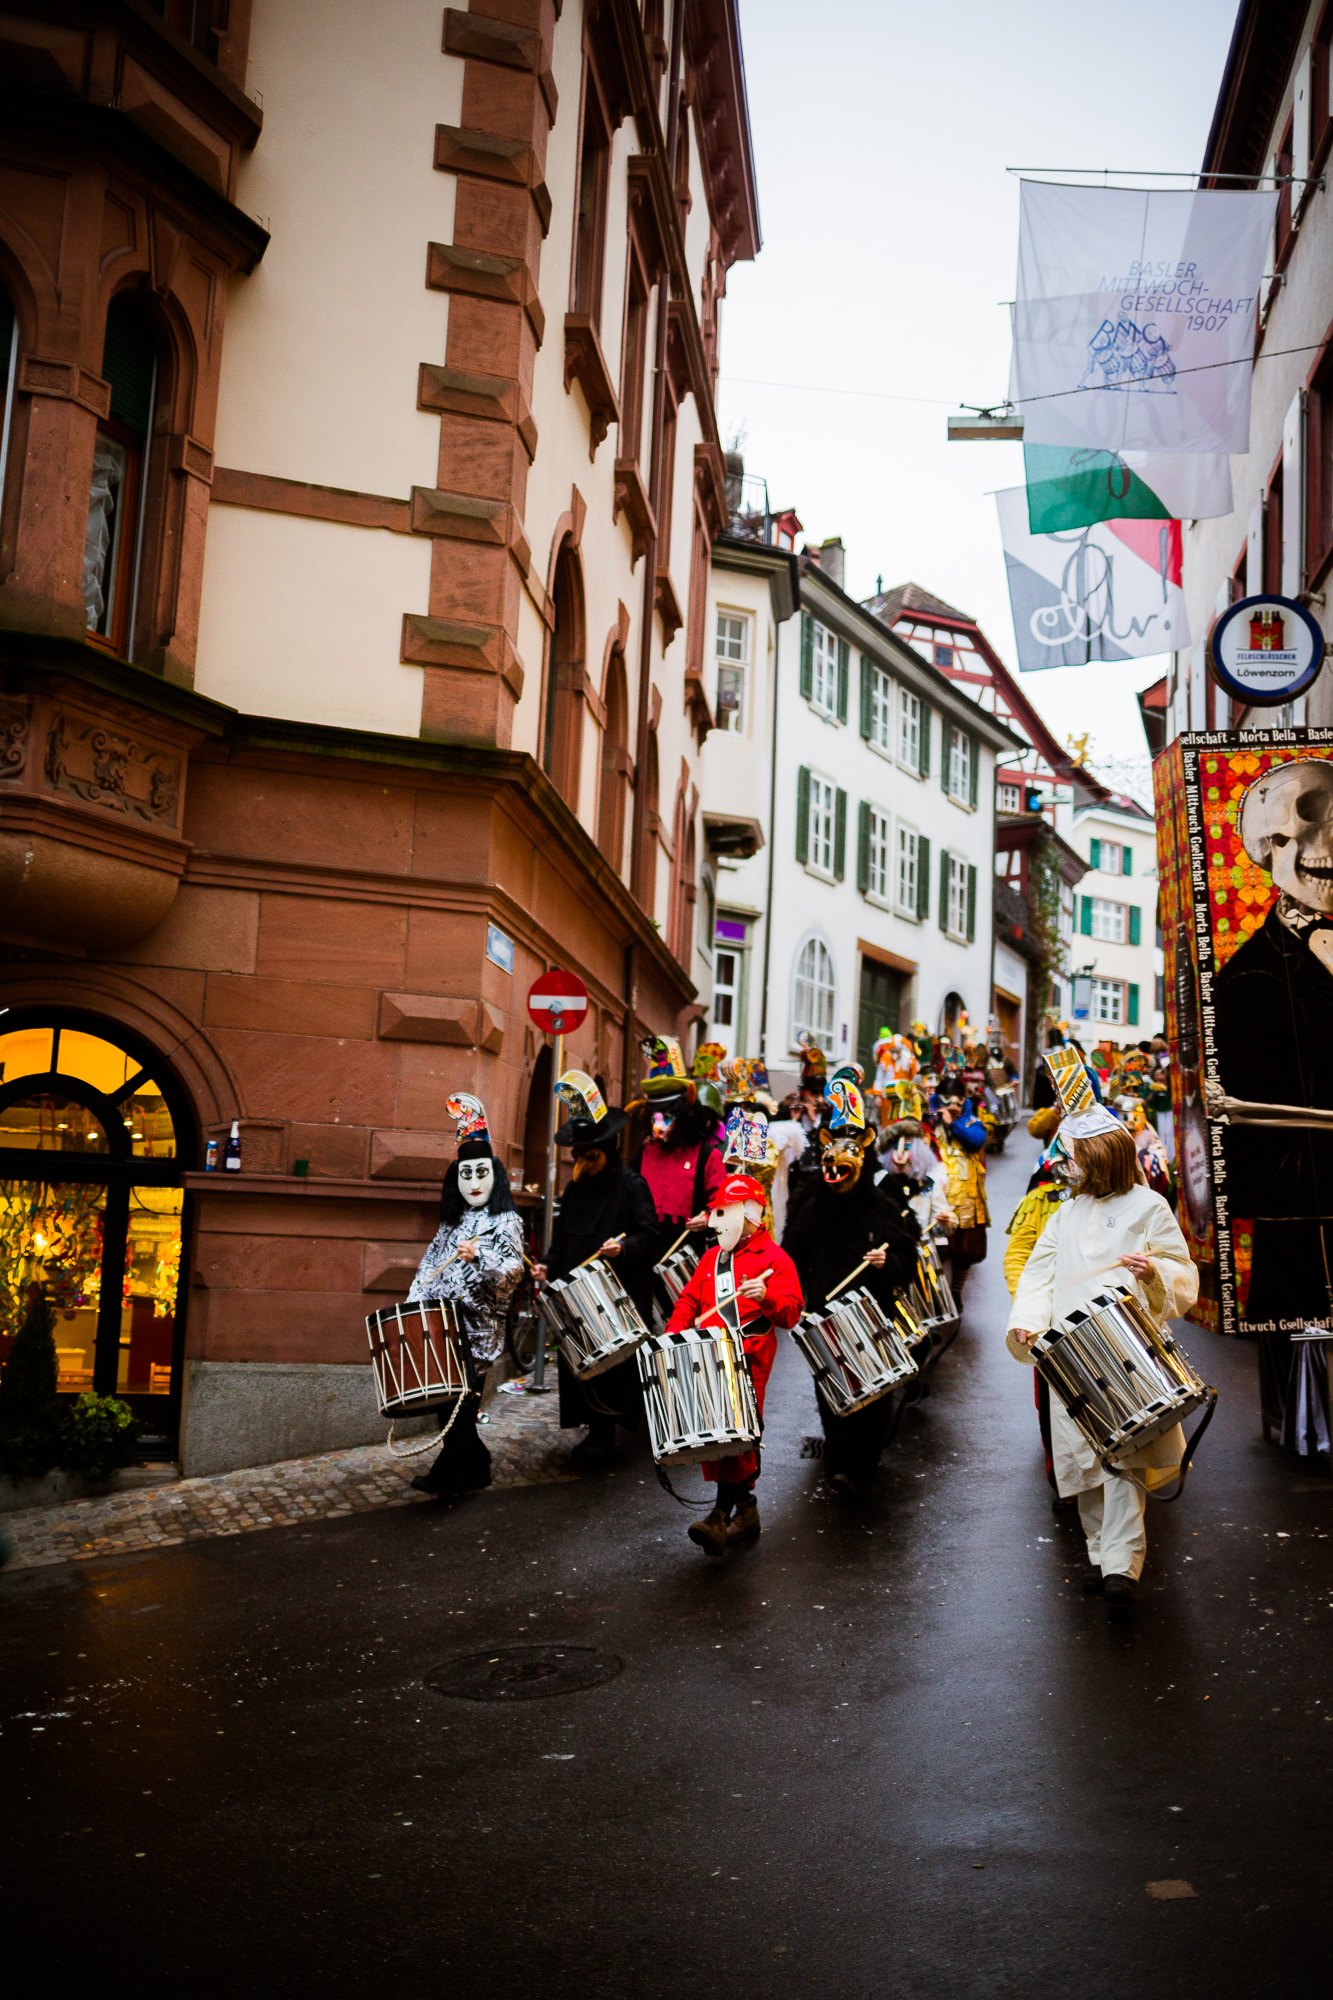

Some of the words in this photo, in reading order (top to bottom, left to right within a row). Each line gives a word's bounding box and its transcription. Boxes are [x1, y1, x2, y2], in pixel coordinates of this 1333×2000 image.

[1129, 261, 1197, 278] BASLER
[1099, 276, 1209, 296] MITTWOCH-
[1120, 295, 1254, 314] GESELLSCHAFT
[1186, 315, 1228, 332] 1907
[1237, 668, 1296, 677] Löwenzorn
[1239, 731, 1270, 743] Morta
[1273, 729, 1296, 741] Bella
[1183, 751, 1197, 782] Basler
[1186, 785, 1202, 834] Mittwuch
[1190, 836, 1206, 892] Gsellschaft
[1195, 903, 1208, 934] Morta
[1197, 936, 1211, 961] Bella
[1200, 971, 1214, 1003] Basler
[1202, 1006, 1218, 1055] Mittwuch
[1210, 1126, 1224, 1157] Morta
[1213, 1159, 1227, 1184] Bella
[1215, 1195, 1229, 1227] Basler
[1217, 1230, 1233, 1280] Mittwuch
